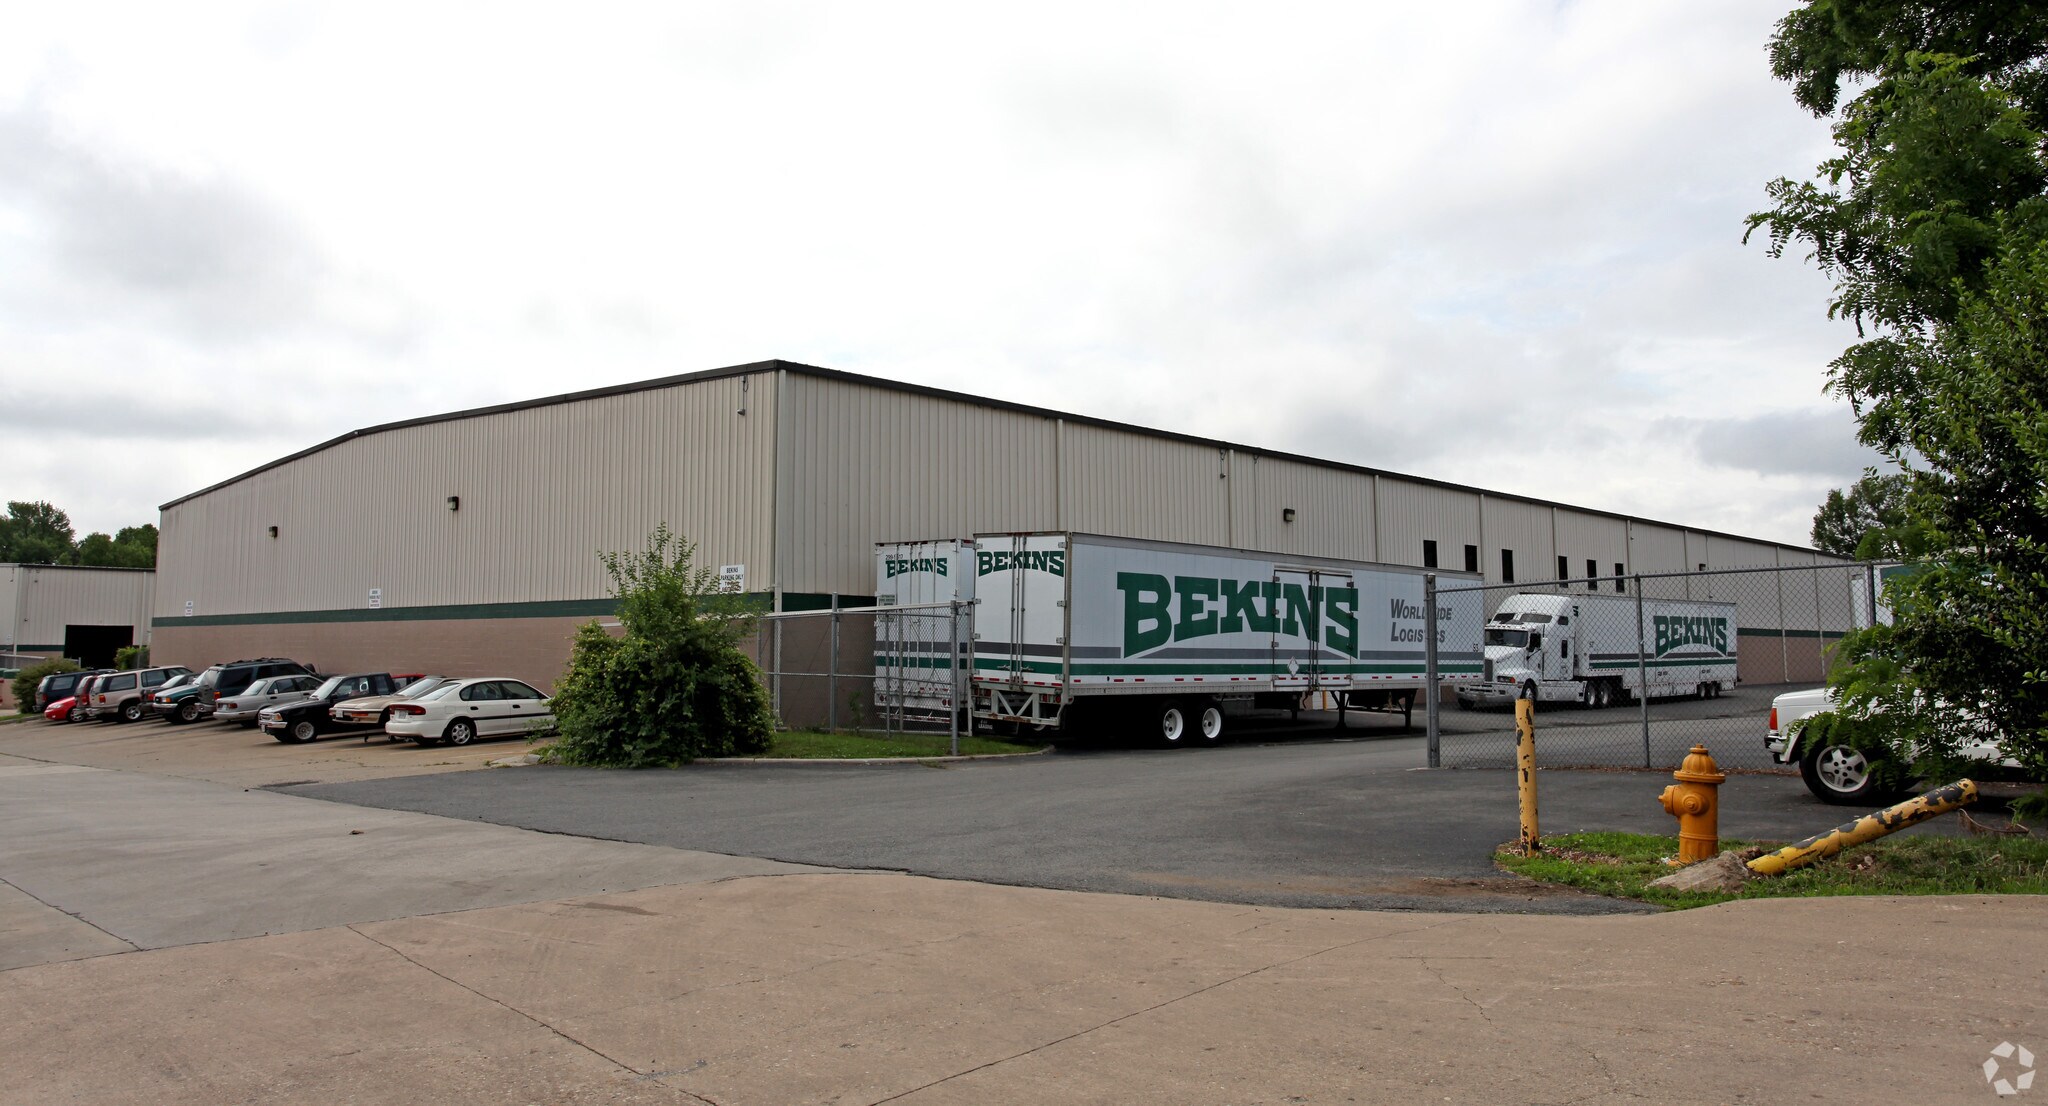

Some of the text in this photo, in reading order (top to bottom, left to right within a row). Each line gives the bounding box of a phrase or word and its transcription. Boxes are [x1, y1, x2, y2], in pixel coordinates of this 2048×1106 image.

[885, 557, 948, 579] BEKINS
[977, 550, 1065, 577] BEKINS
[1117, 571, 1359, 660] BEKINS
[1390, 598, 1453, 621] WORLIDE
[1390, 621, 1446, 643] LOGISS
[1653, 615, 1727, 659] BEKINS
